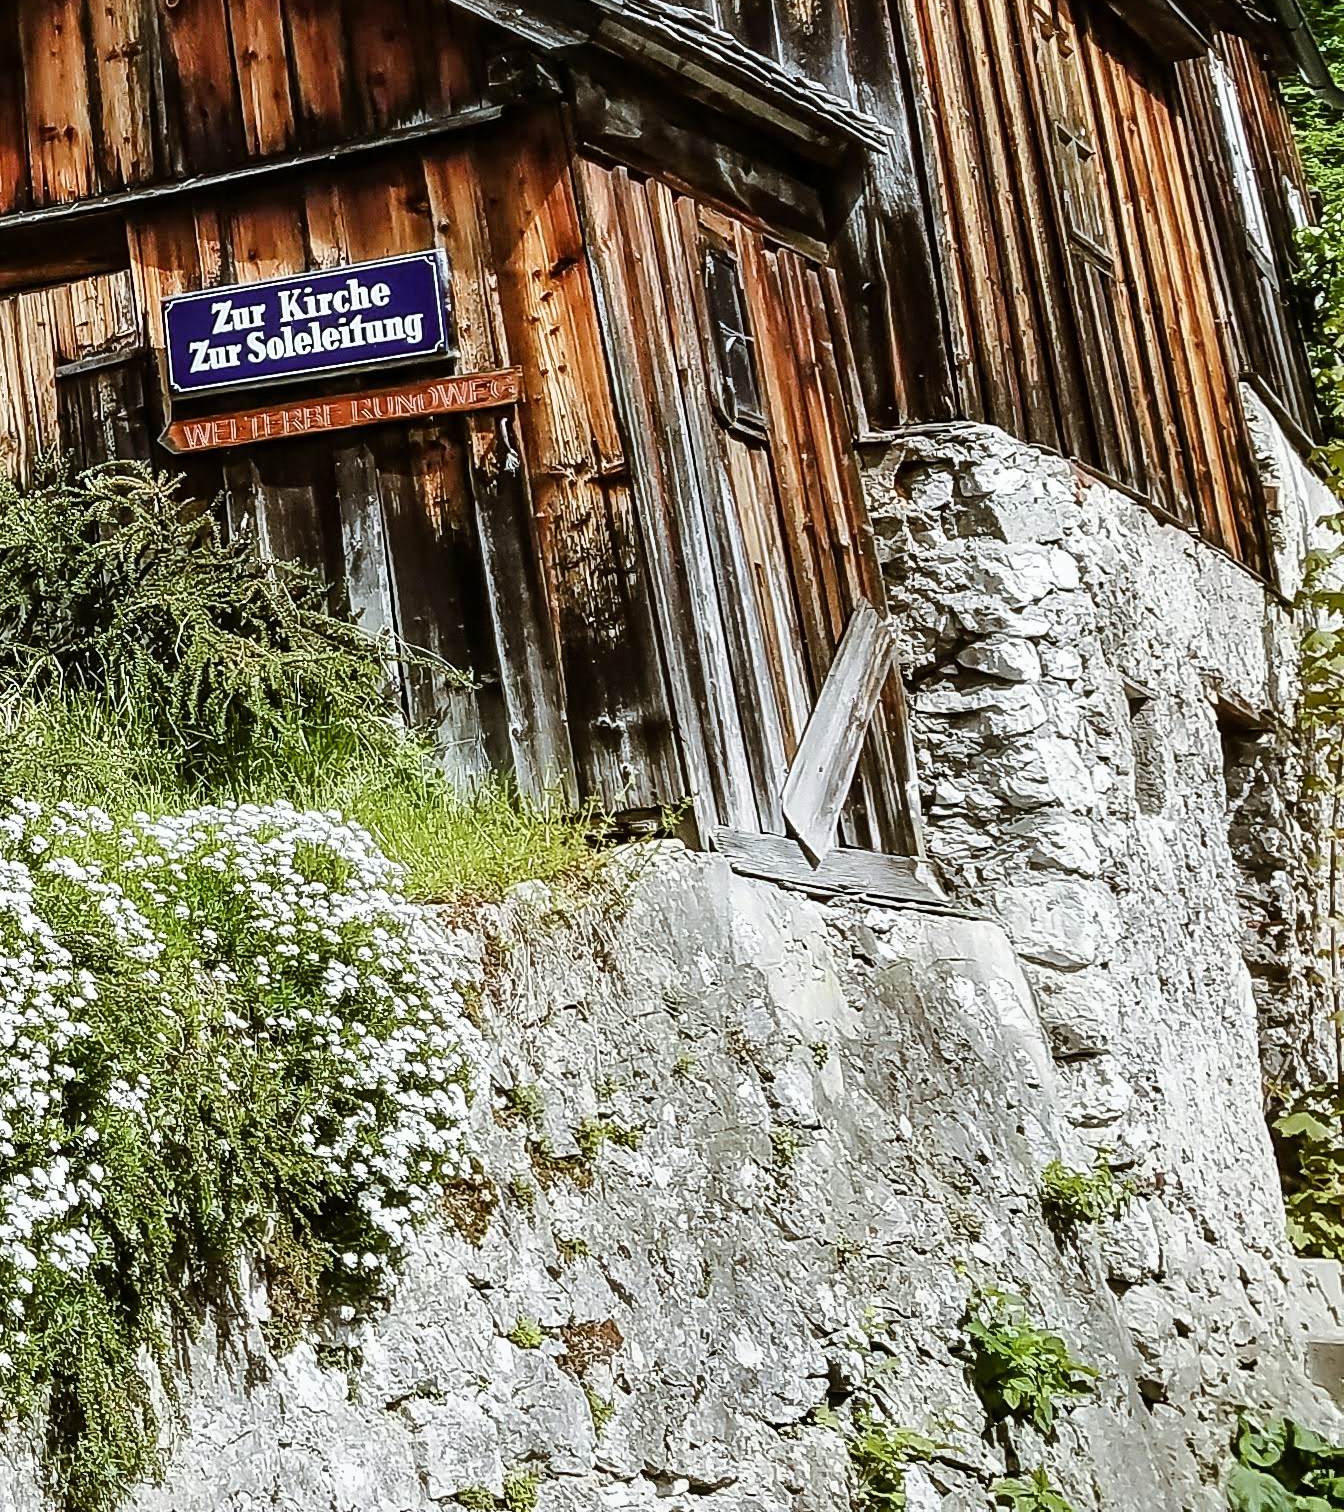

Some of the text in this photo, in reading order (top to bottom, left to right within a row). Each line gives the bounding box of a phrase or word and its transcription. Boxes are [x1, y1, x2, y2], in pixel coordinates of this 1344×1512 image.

[211, 278, 391, 335] Zur Kirche
[189, 313, 424, 374] Zur Soleleitung
[183, 375, 515, 449] WELTERBE RUNDWEG
